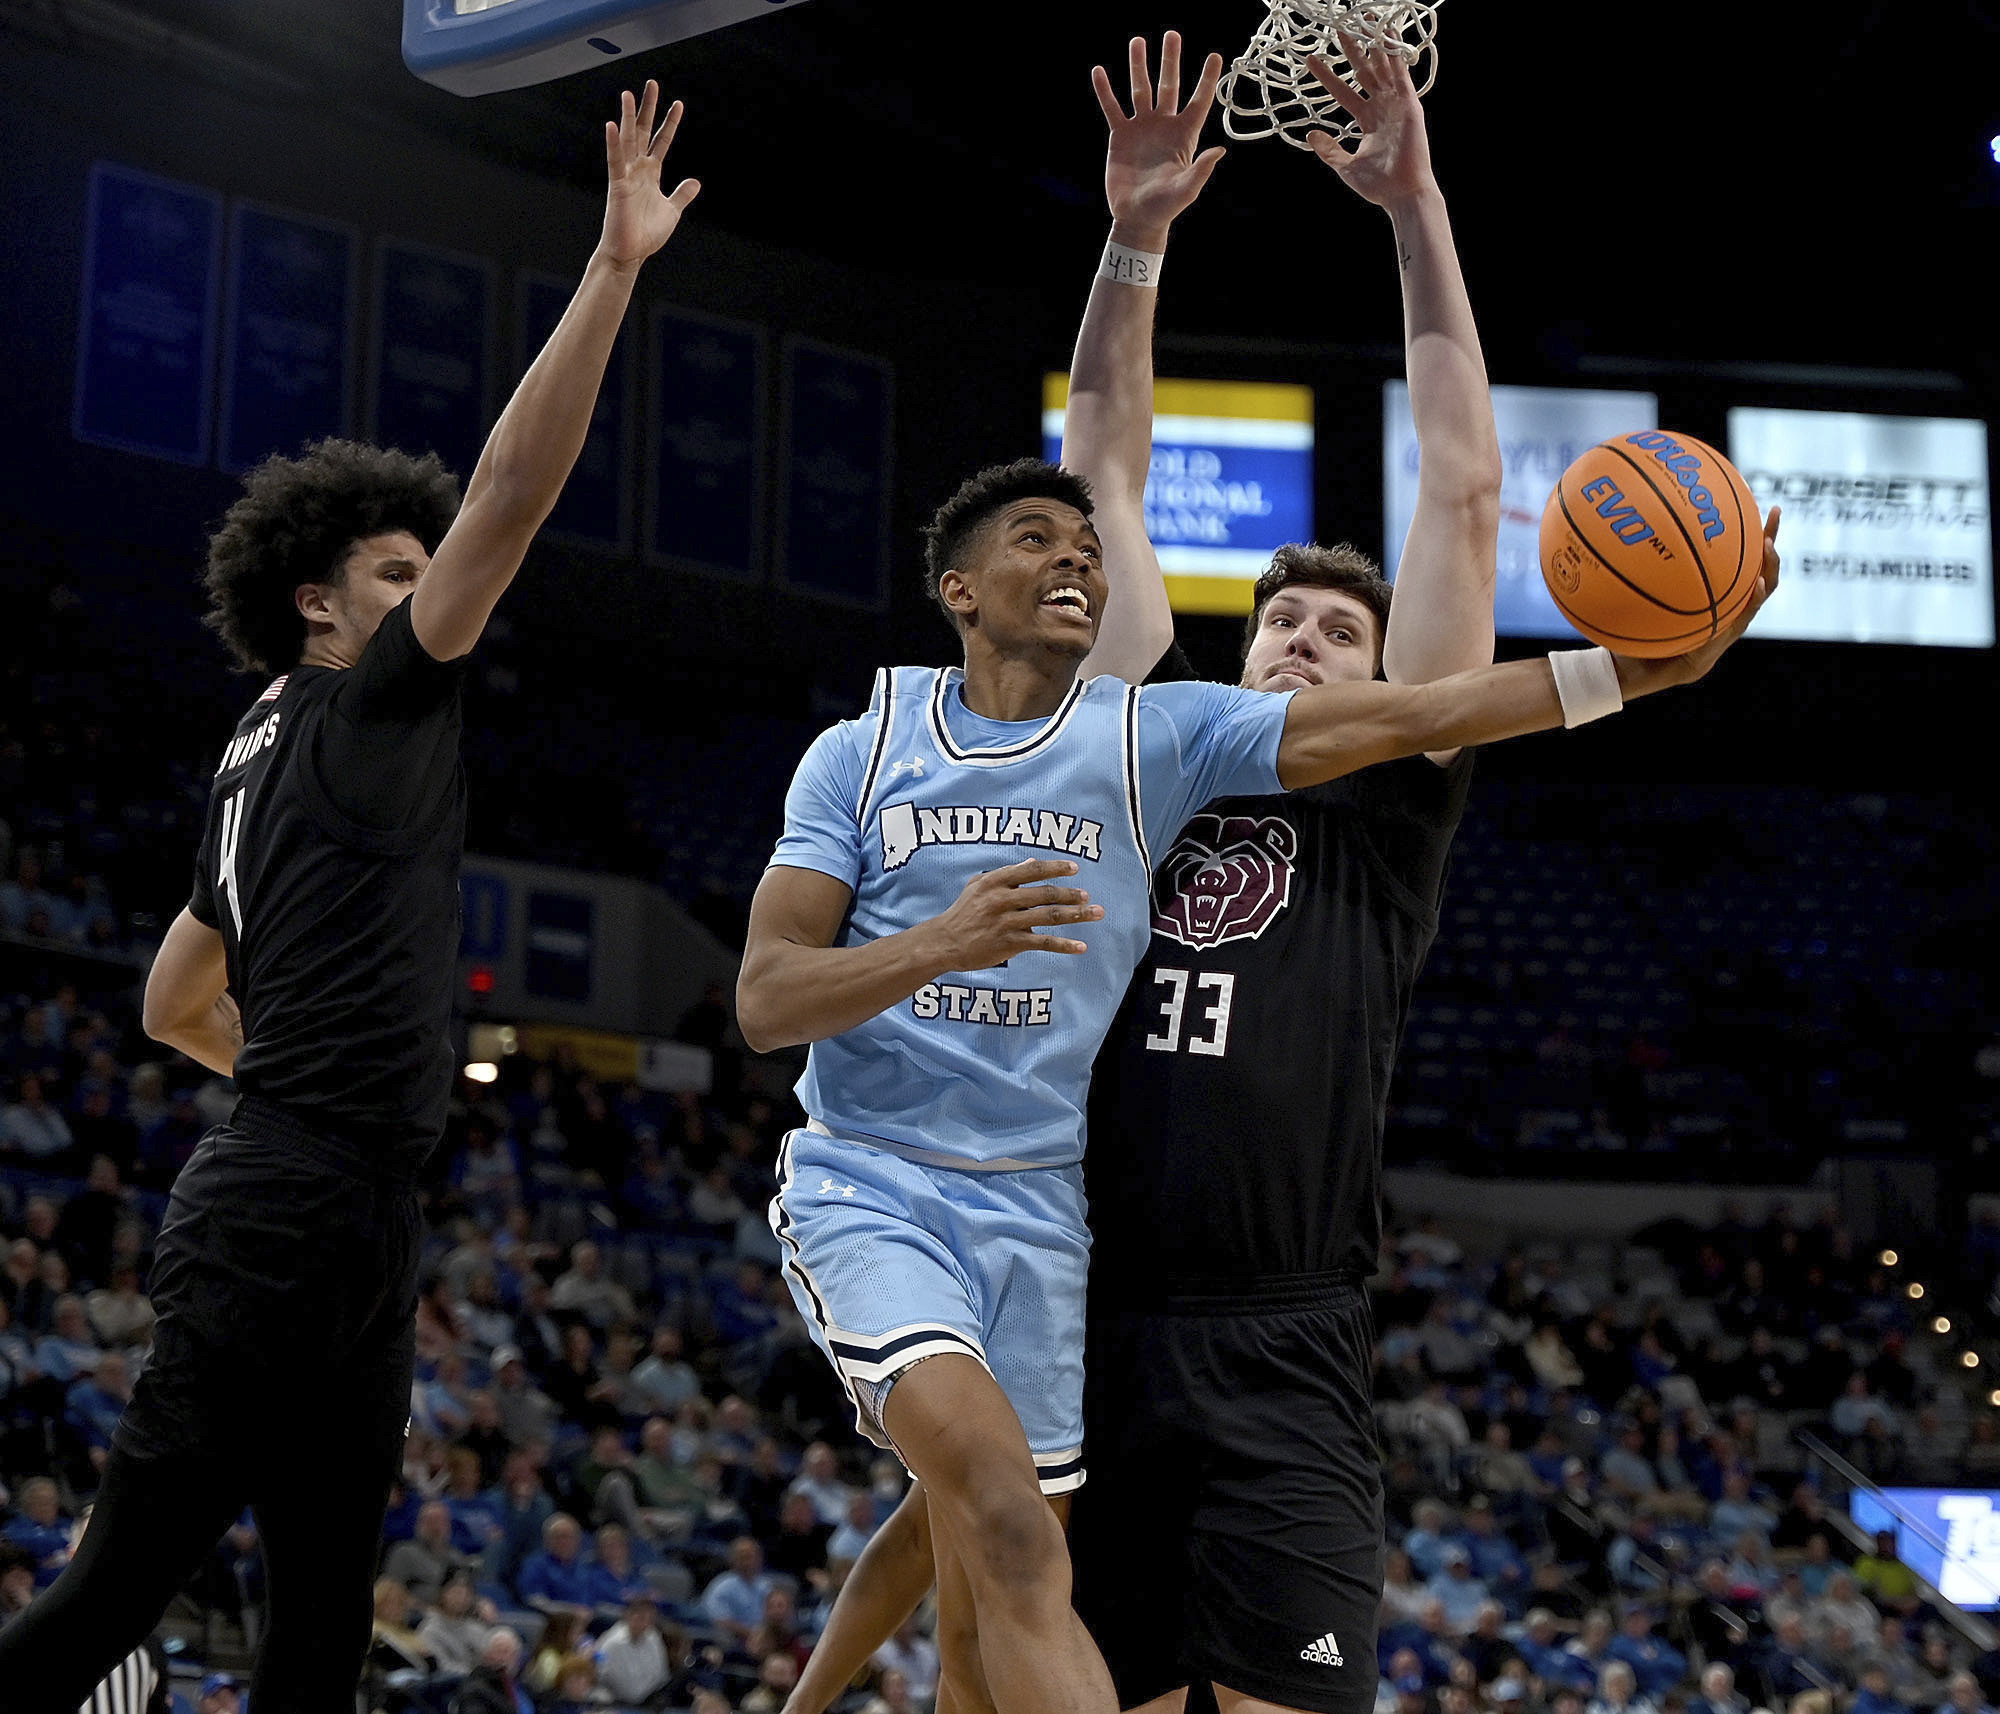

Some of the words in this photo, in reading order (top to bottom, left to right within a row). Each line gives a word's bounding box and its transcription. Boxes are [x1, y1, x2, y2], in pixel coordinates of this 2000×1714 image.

[1108, 250, 1149, 282] 4:13
[1580, 476, 1655, 545] EVO
[1626, 431, 1725, 542] Wilson
[1648, 536, 1676, 561] NXT
[217, 786, 247, 943] 4
[912, 983, 1053, 1027] STATE
[1146, 967, 1237, 1058] 33
[1300, 1649, 1344, 1668] adidas
